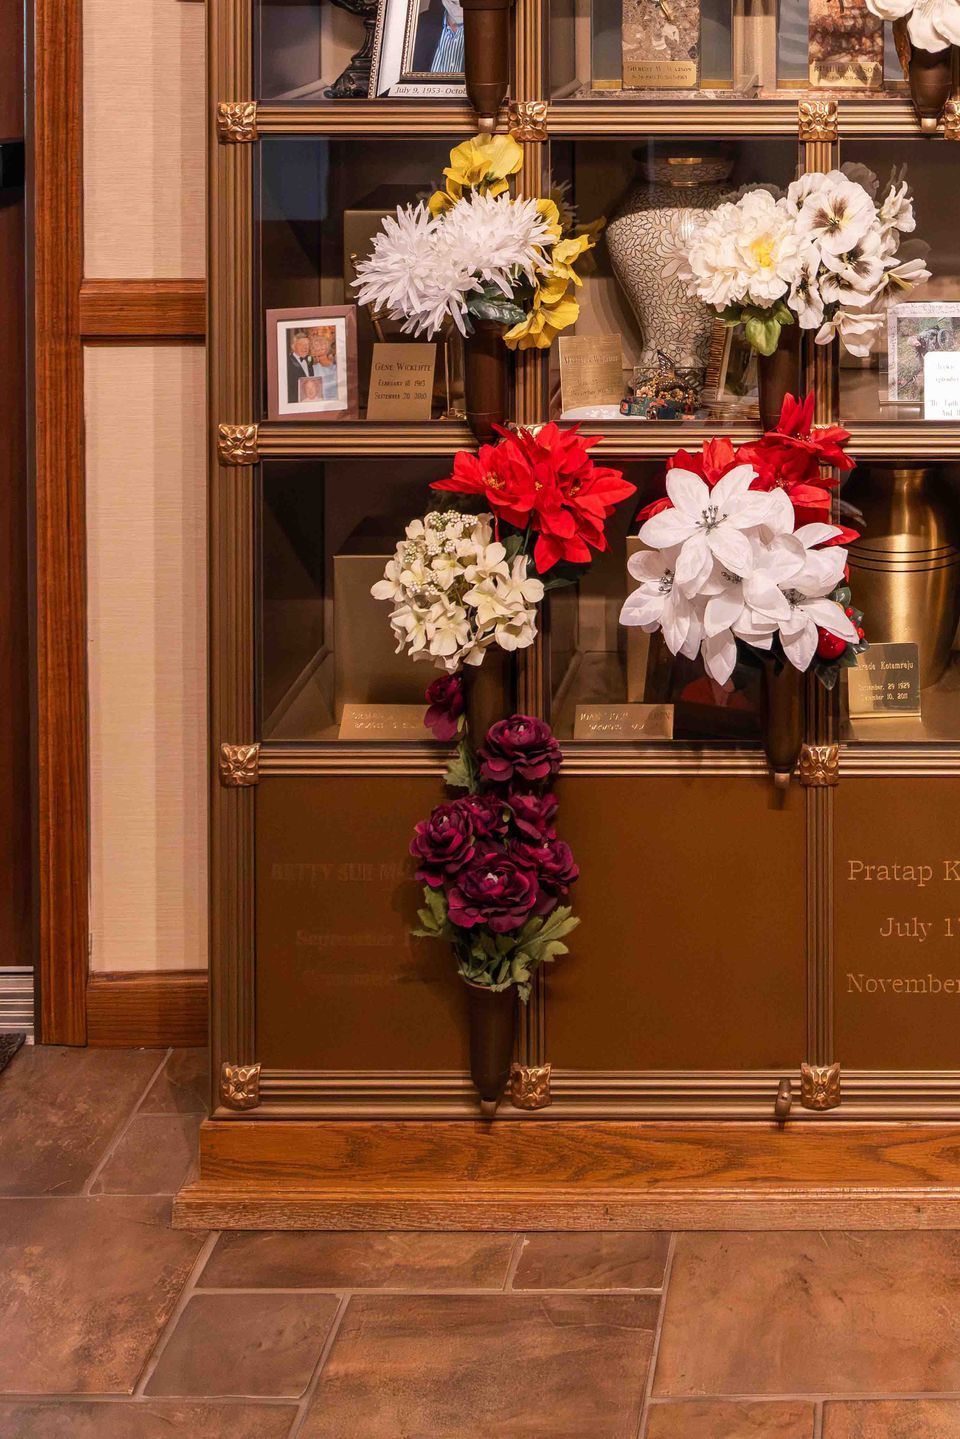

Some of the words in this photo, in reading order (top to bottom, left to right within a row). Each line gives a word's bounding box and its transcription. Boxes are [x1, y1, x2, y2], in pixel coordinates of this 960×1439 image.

[395, 86, 410, 94] July
[847, 860, 933, 887] Pratap
[879, 917, 932, 943] July
